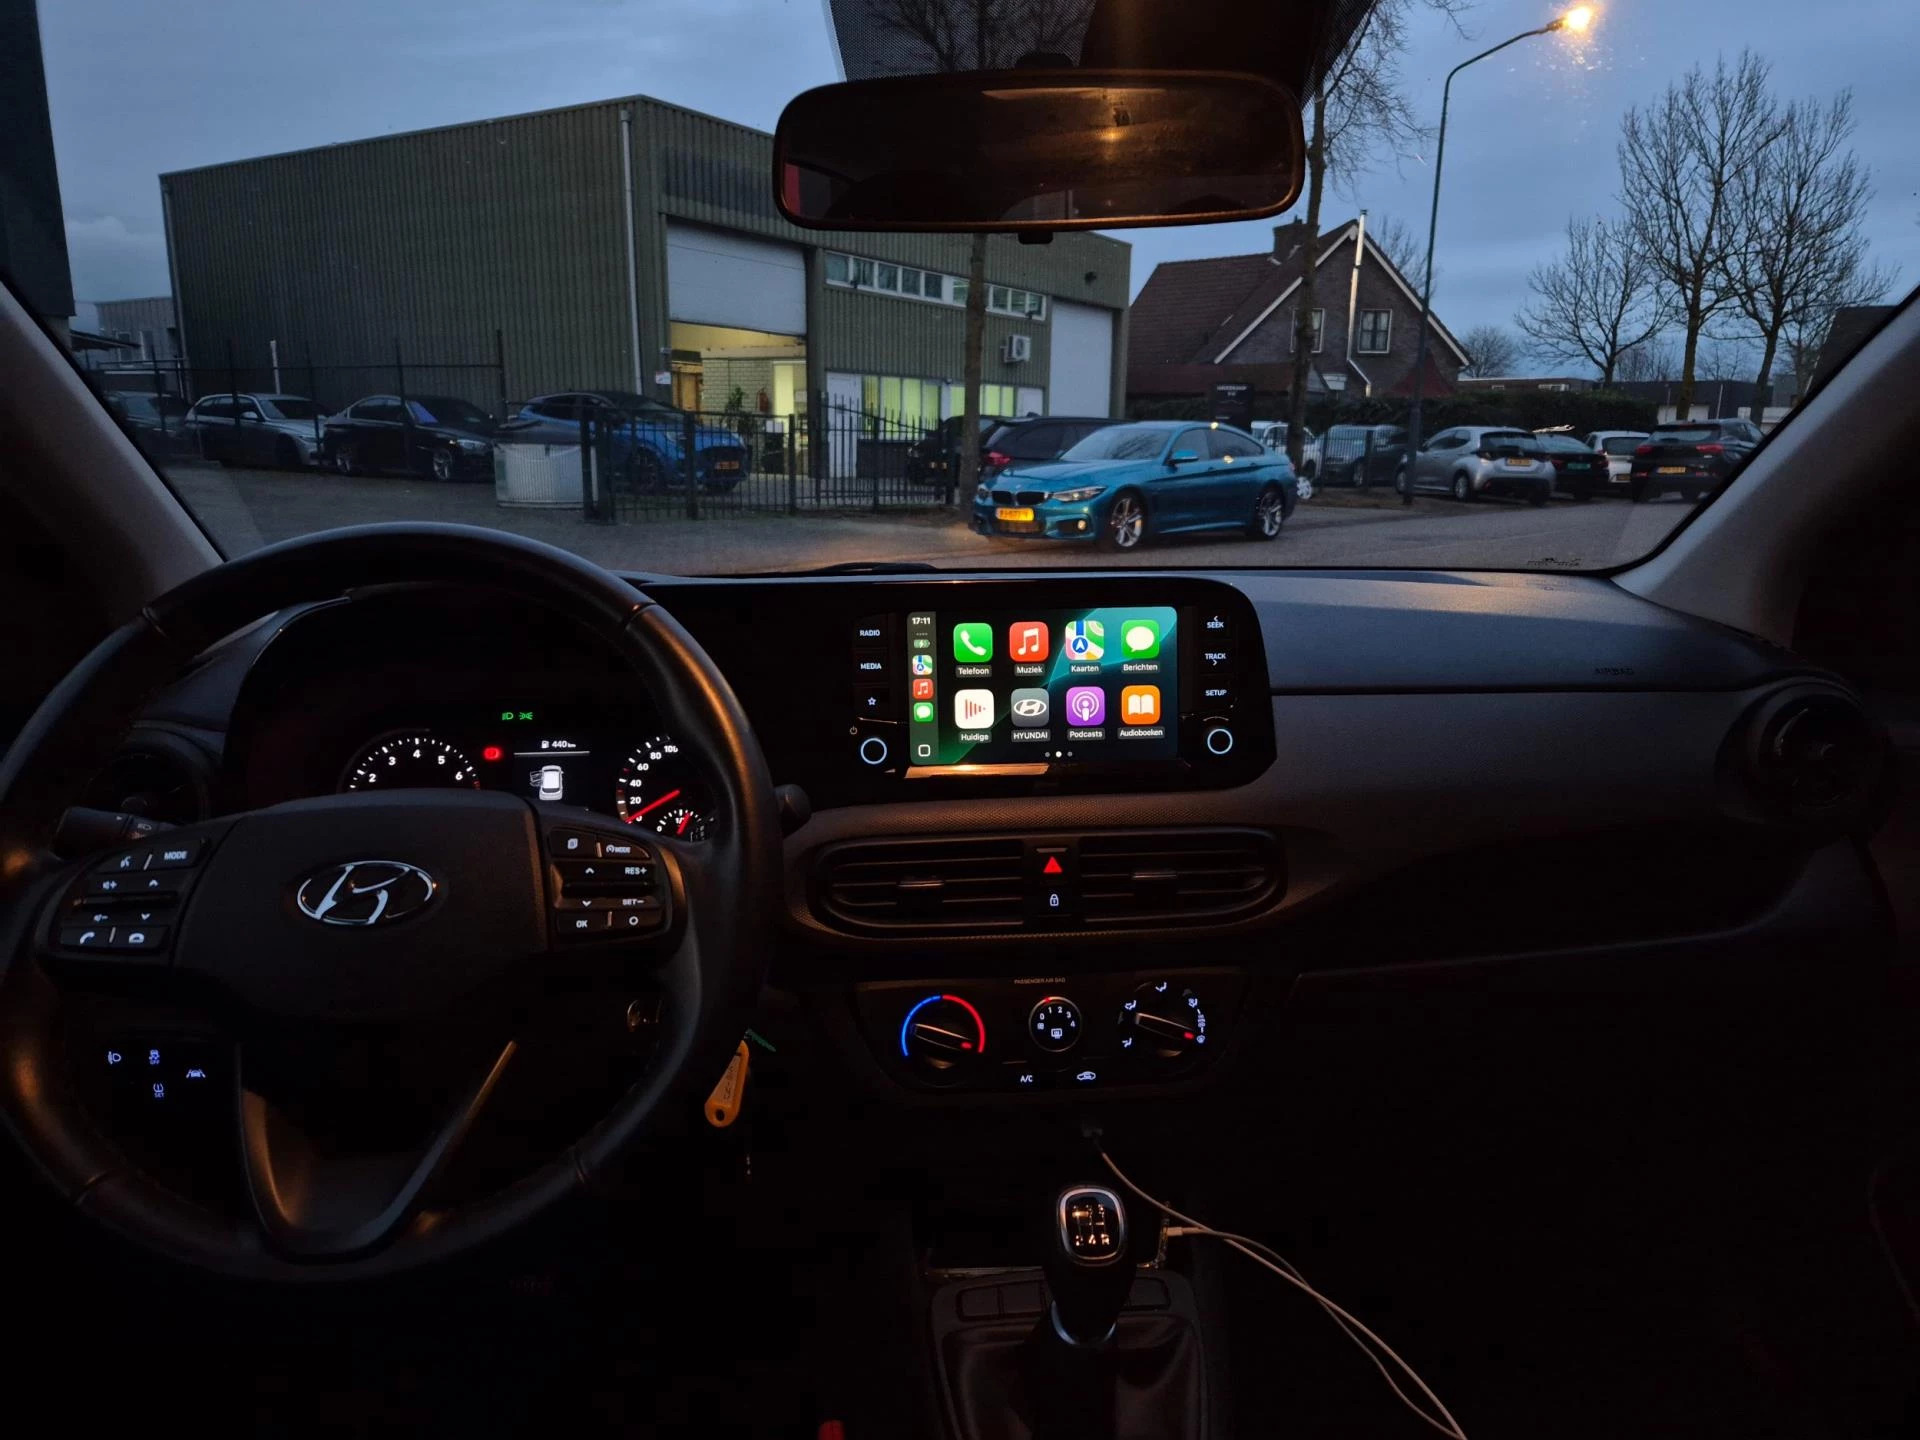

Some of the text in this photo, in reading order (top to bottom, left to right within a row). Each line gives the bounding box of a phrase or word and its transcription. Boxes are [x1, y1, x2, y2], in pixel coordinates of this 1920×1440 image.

[911, 617, 931, 625] 17:11
[1206, 621, 1225, 629] SEEK
[859, 629, 881, 637] RADIO
[1204, 652, 1227, 660] TRACK
[860, 662, 882, 670] MEDIA
[1016, 665, 1043, 674] Muziek
[1070, 665, 1099, 673] Kaarten
[1122, 663, 1158, 671] Berichten
[957, 667, 990, 675] Telefoon
[1205, 689, 1228, 697] SETUP
[1013, 731, 1048, 740] HYUNDAI
[1069, 730, 1103, 738] Podcasts
[1119, 728, 1163, 737] Audioboeken
[960, 733, 989, 742] Huidige
[412, 749, 421, 759] 4
[649, 751, 662, 760] 80
[388, 756, 396, 766] 3
[437, 755, 446, 765] 5
[636, 762, 649, 771] 60
[368, 773, 377, 783] 2
[455, 771, 463, 781] 6
[629, 779, 642, 788] 40
[629, 796, 642, 805] 20
[656, 825, 663, 833] 0
[163, 850, 187, 860] MODE
[575, 919, 588, 928] OK
[1047, 1006, 1053, 1014] 1
[1057, 1006, 1063, 1014] 2
[1039, 1012, 1045, 1021] 0
[1066, 1011, 1072, 1019] 3
[1070, 1020, 1076, 1028] 4
[1020, 1074, 1033, 1083] A/C
